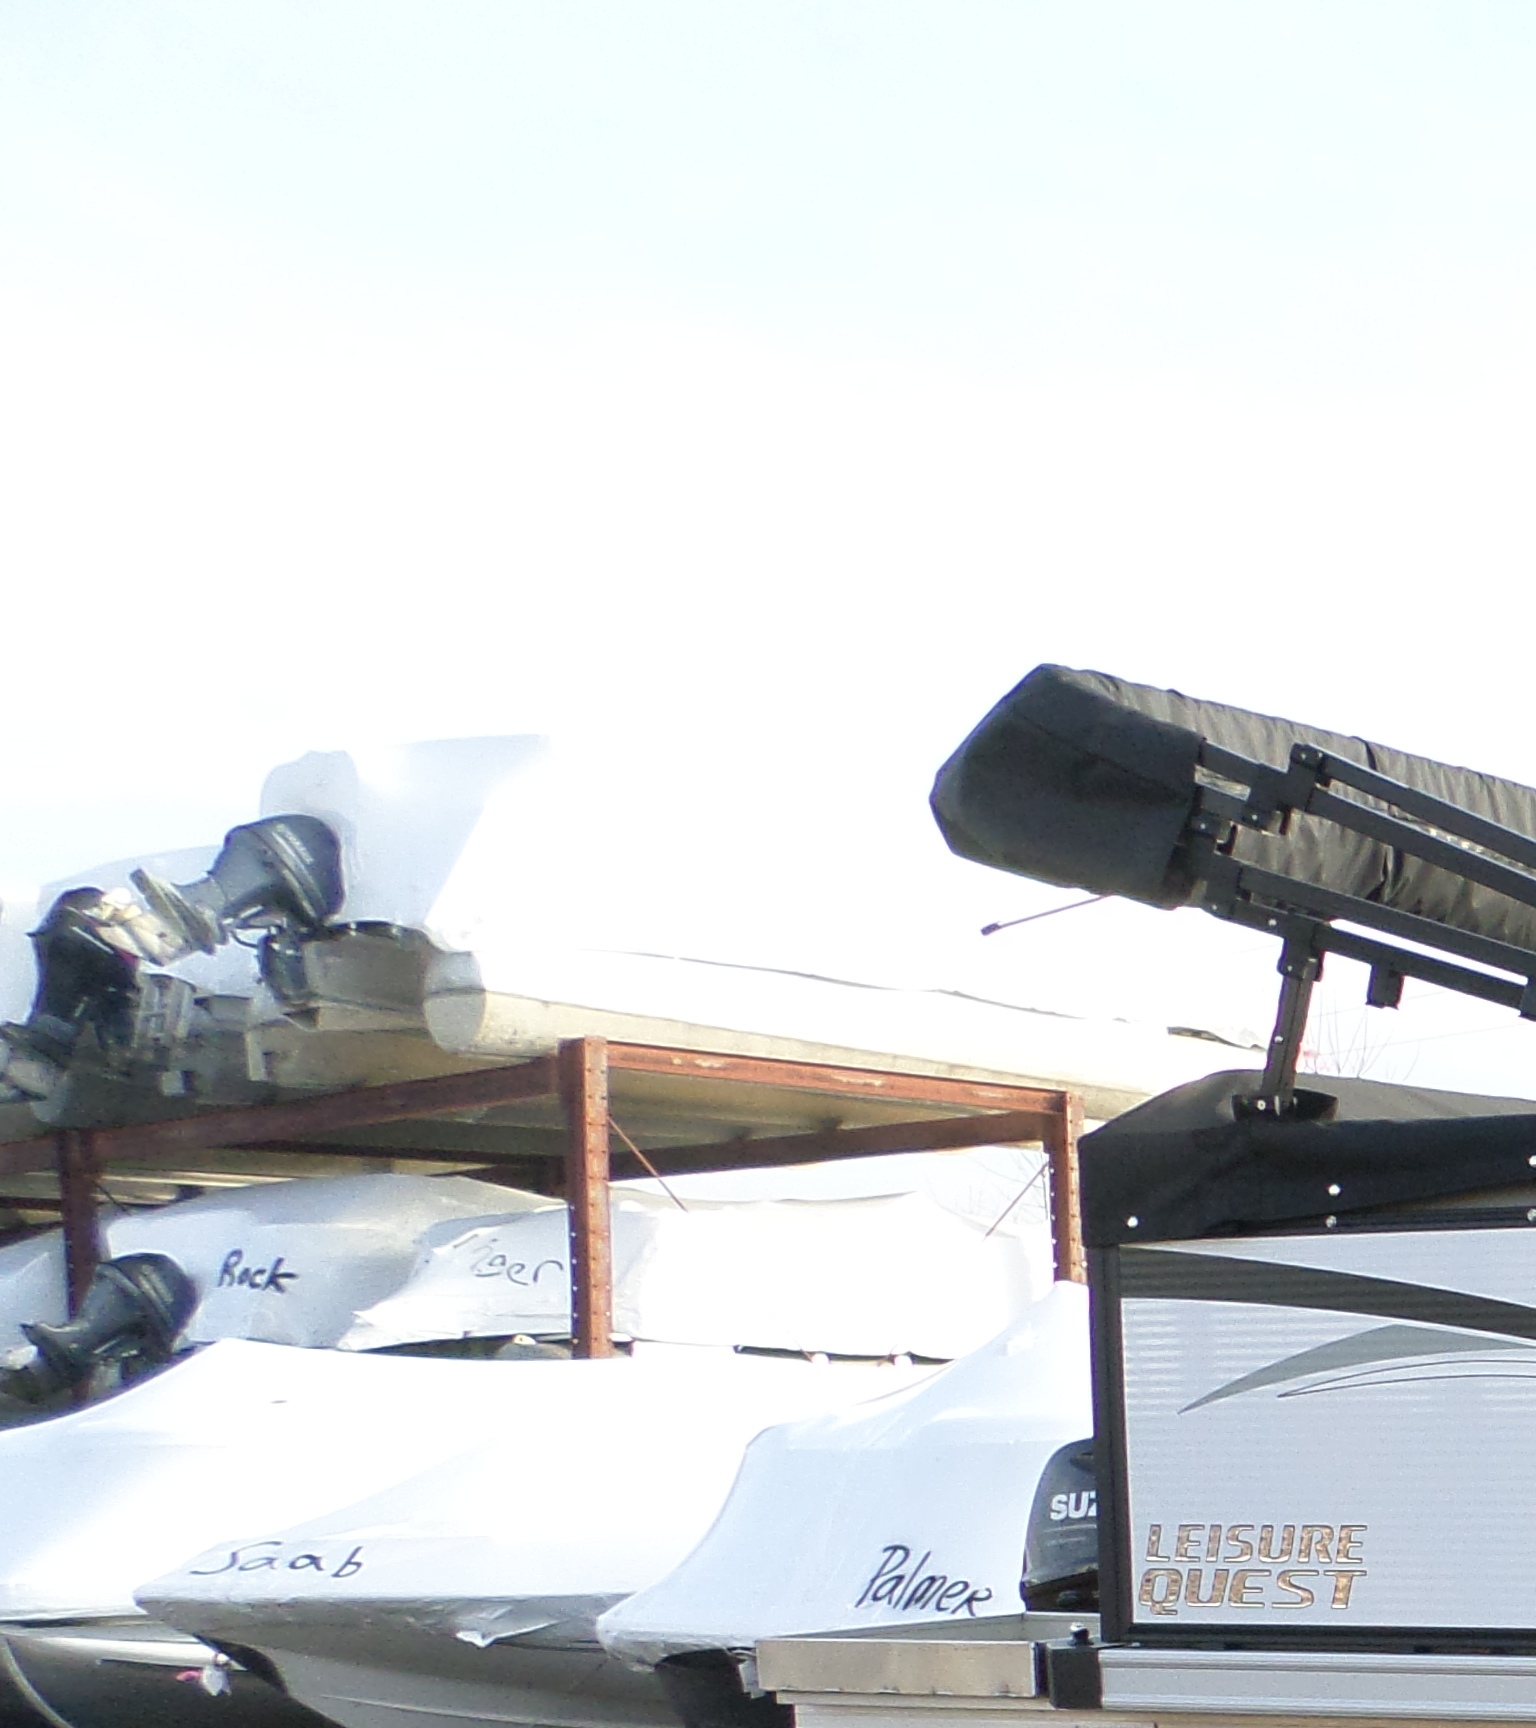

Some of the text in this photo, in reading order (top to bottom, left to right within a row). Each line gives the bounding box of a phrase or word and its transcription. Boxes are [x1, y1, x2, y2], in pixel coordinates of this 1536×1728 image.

[188, 1540, 364, 1578] Saab
[1145, 1523, 1368, 1564] LEISURE
[1138, 1567, 1368, 1616] QUEST
